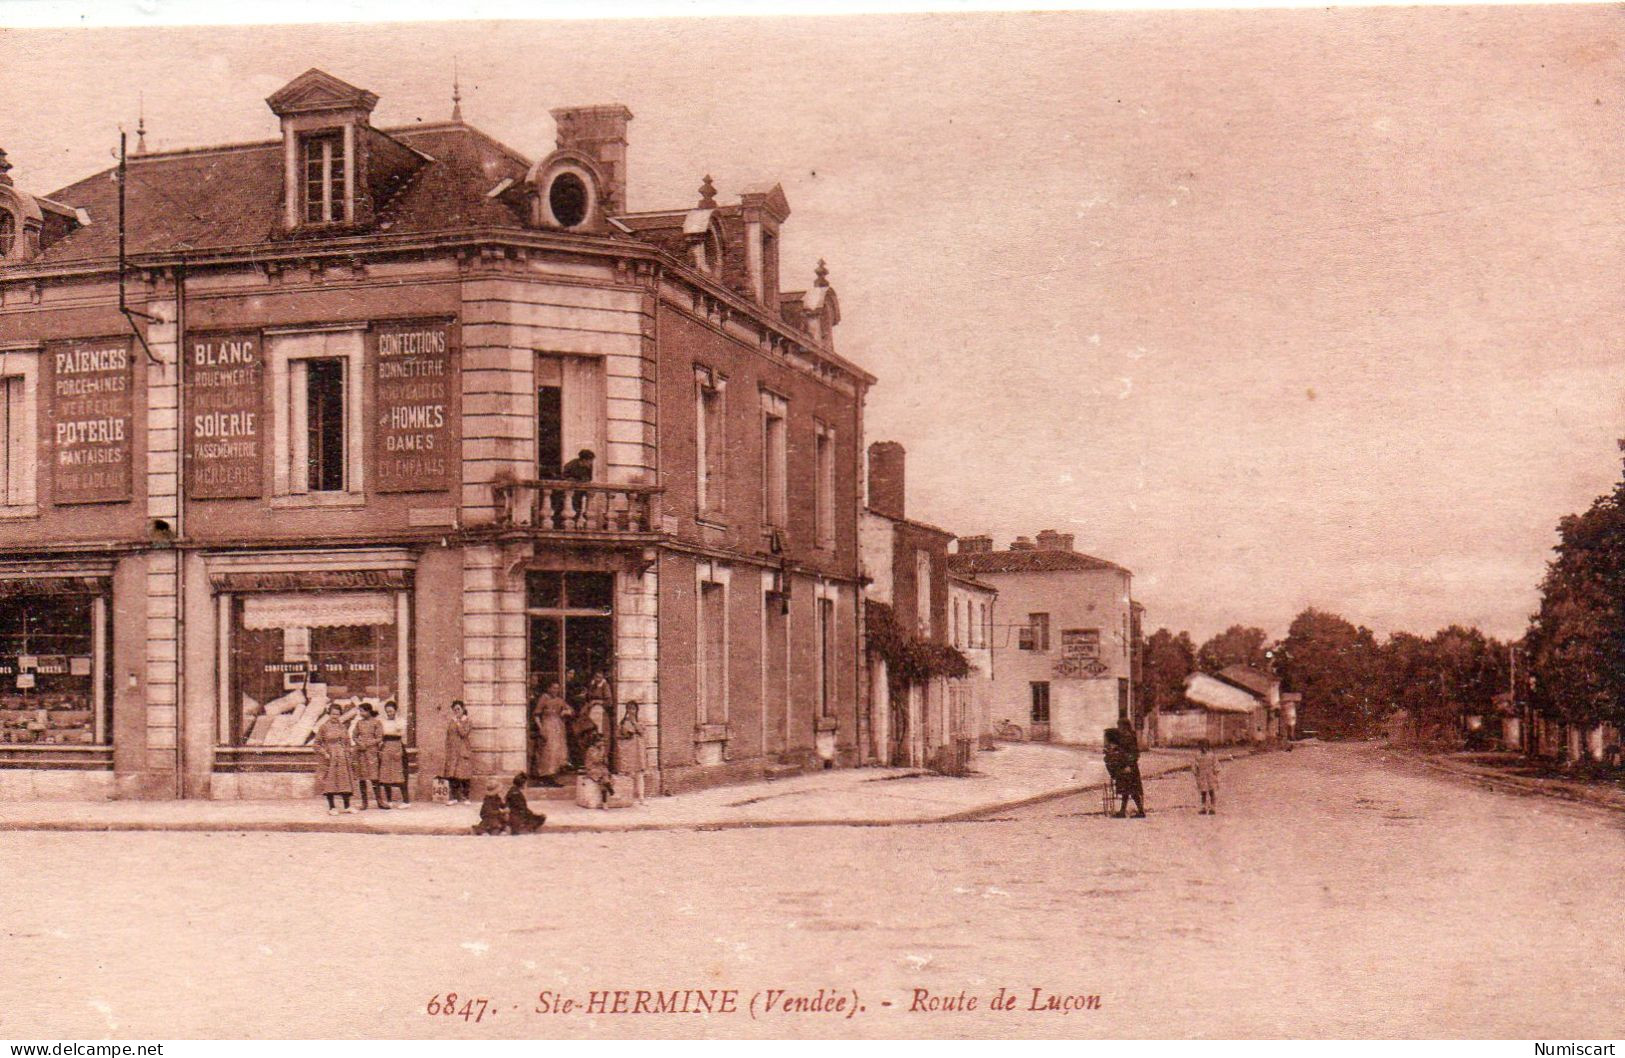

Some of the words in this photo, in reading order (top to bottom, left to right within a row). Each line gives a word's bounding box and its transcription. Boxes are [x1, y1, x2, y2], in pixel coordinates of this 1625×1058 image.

[379, 330, 445, 356] CONFECTIONS
[195, 342, 253, 365] BLANC
[194, 368, 256, 387] ROUENNERIE
[379, 360, 444, 378] BONNETTERIE
[56, 376, 126, 396] PORCELAINES
[194, 411, 256, 438] SOIERIE
[391, 405, 444, 429] HOMMES
[56, 416, 125, 444] POTERIE
[194, 442, 257, 459] PASSEMENTERIE
[386, 434, 434, 451] DAMES
[59, 447, 122, 465] FANTAISIES
